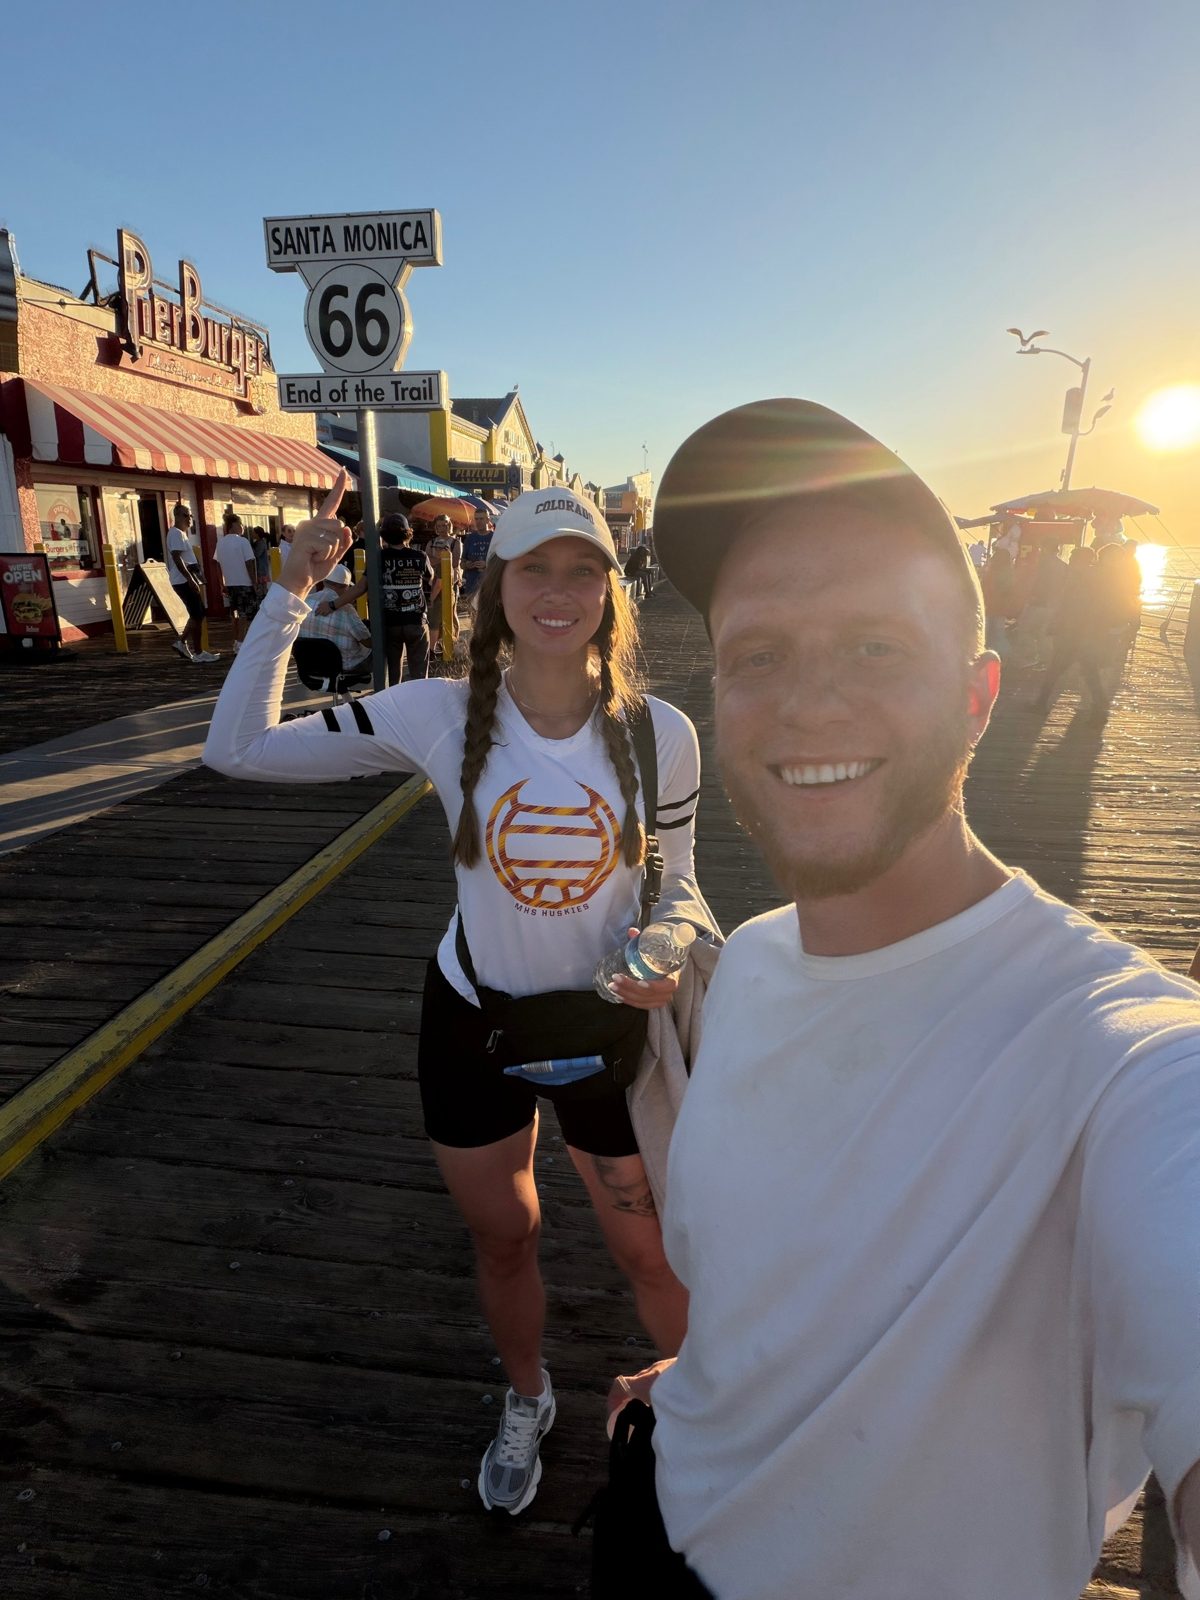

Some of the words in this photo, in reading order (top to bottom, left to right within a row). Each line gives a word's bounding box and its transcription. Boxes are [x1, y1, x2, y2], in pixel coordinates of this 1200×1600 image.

[271, 224, 336, 256] SANTA
[343, 220, 428, 252] MONICA
[179, 259, 266, 397] Burger
[318, 282, 390, 358] 66
[286, 380, 321, 404] End
[328, 379, 348, 401] of
[355, 379, 385, 401] the
[391, 376, 433, 401] Trail
[455, 468, 499, 478] PLAYLAND
[535, 499, 594, 525] COLORADO
[3, 570, 42, 584] OPEN
[514, 902, 537, 916] MHS
[542, 903, 590, 917] HUSKIES
